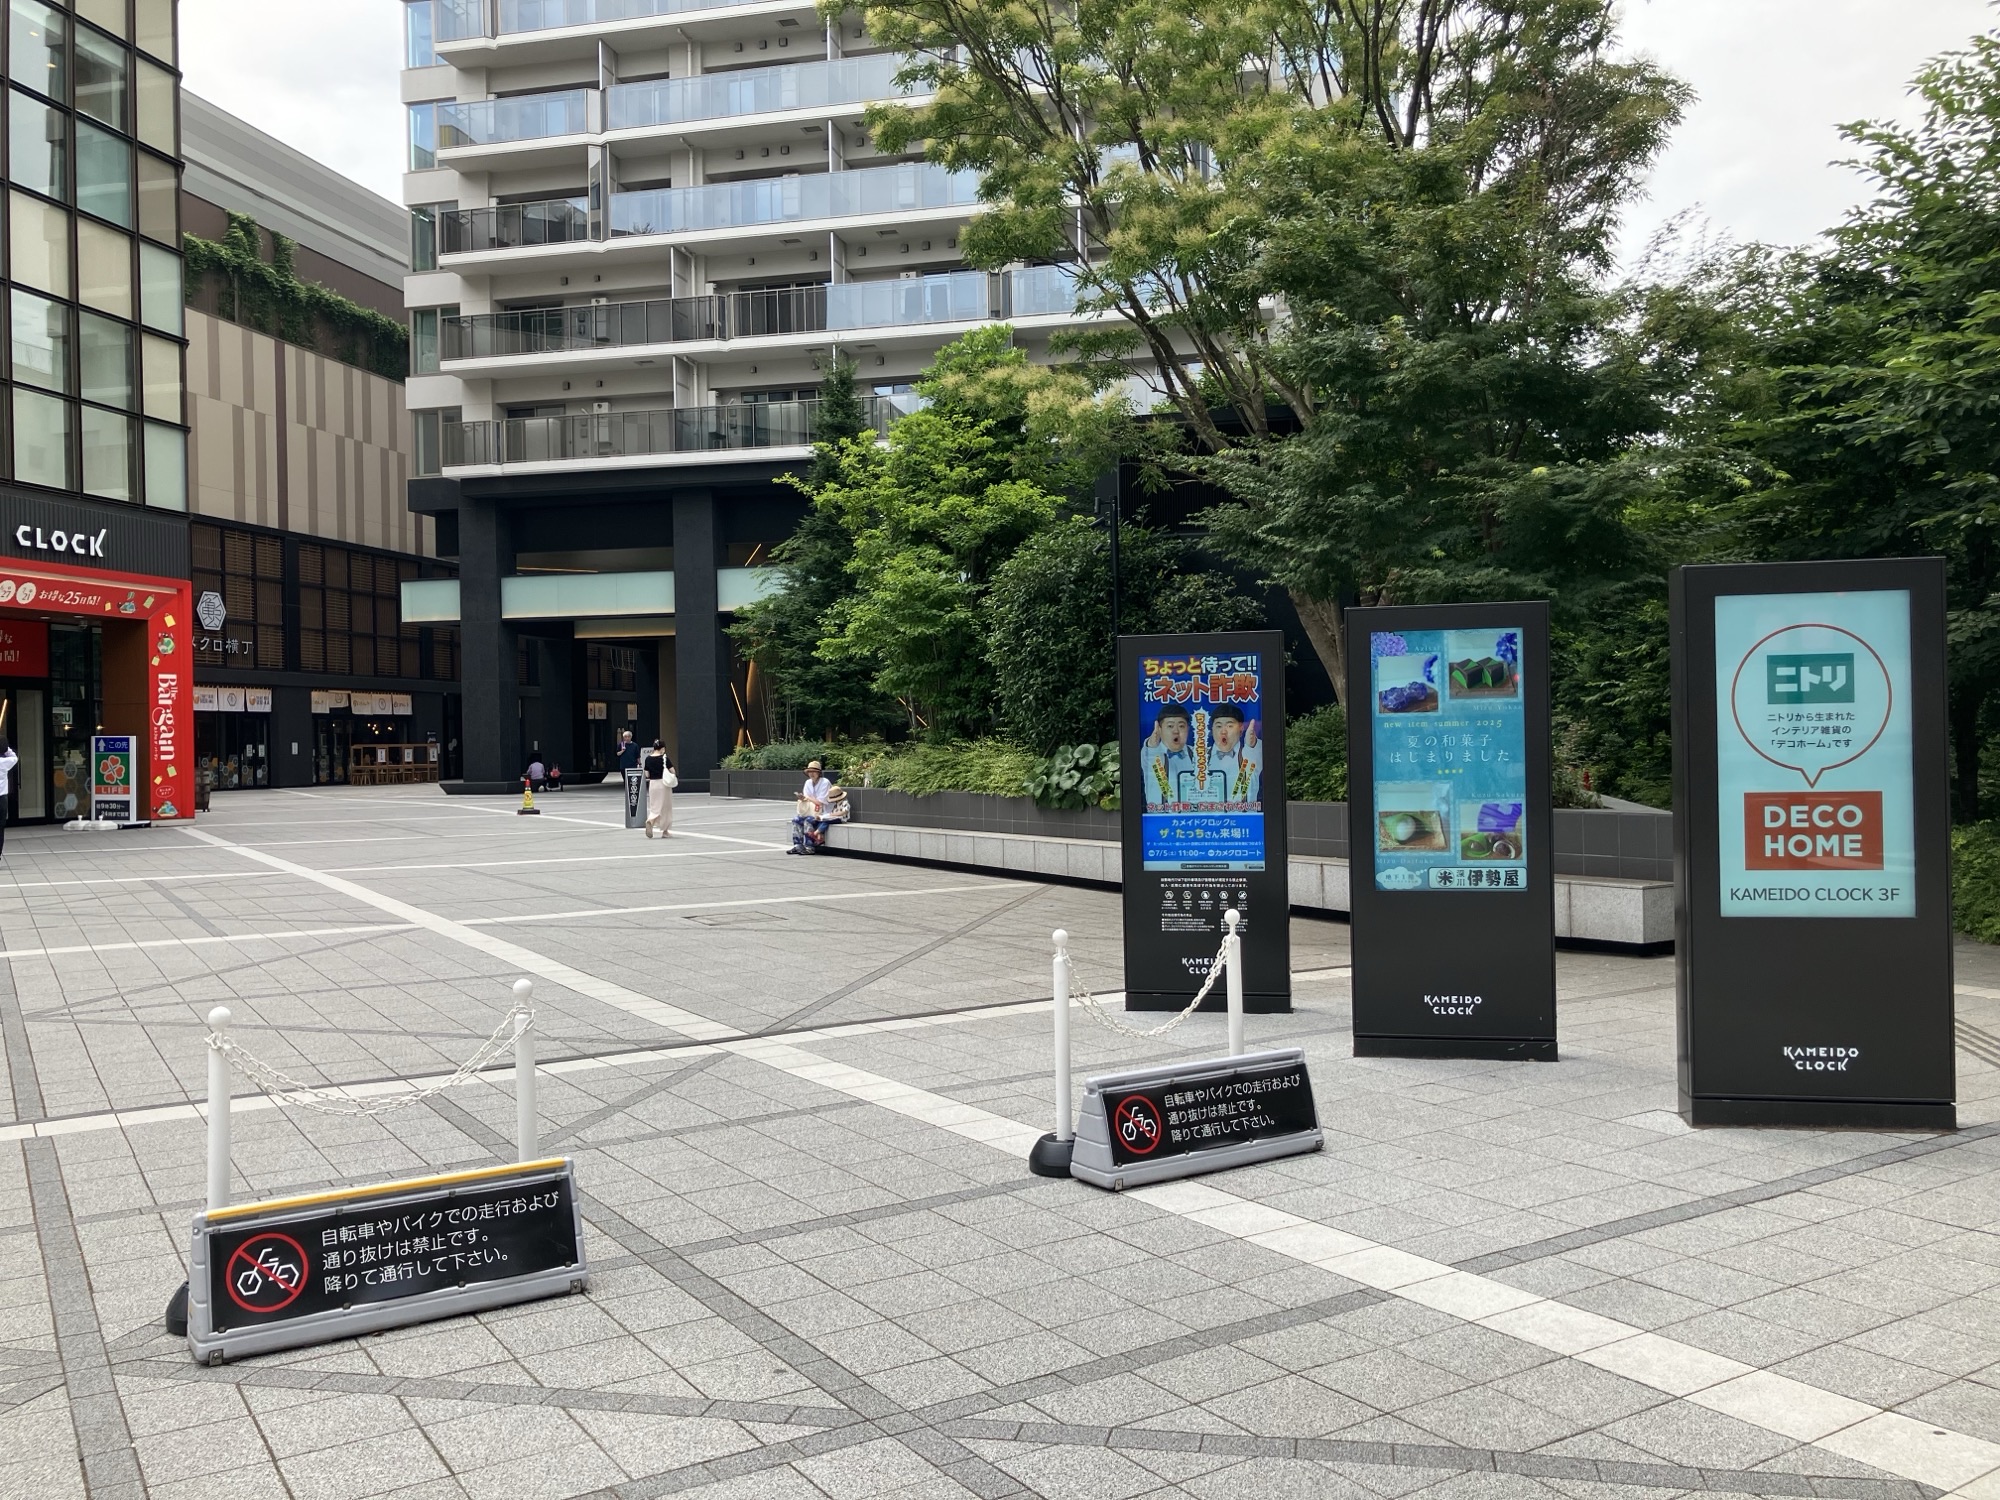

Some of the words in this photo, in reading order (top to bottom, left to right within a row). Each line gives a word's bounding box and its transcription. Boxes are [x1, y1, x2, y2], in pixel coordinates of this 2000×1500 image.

[16, 525, 107, 557] CLOCK
[39, 589, 101, 606] お得な25日間!
[1143, 655, 1257, 675] ちょっと待って!!
[1775, 665, 1847, 692] ニトリ
[1144, 678, 1154, 702] それ
[1154, 672, 1260, 704] ネット詐欺
[152, 673, 177, 760] Bargain
[1408, 719, 1428, 727] item
[1476, 719, 1502, 728] 2025
[1767, 712, 1855, 722] ニトリから生まれた
[1771, 725, 1852, 735] インテリア雑貨の
[108, 741, 128, 749] この先
[1407, 733, 1492, 748] 夏の和菓子
[1771, 738, 1852, 748] 「デコホーム」です
[1390, 750, 1510, 763] はじまりました
[101, 786, 124, 794] LIFE
[1172, 818, 1236, 826] カメイドクロックに
[1764, 804, 1863, 828] DECO
[1159, 828, 1250, 839] ザ・たっちさん来場!!
[1764, 834, 1863, 857] HOME
[1467, 869, 1520, 887] 伊勢屋
[1730, 887, 1810, 901] KAMEIDO
[1815, 887, 1873, 901] CLOCK
[1878, 887, 1900, 901] 3F
[1181, 957, 1223, 967] KAMEI
[1424, 995, 1482, 1006] KAMEIDO
[1432, 1004, 1474, 1015] CLOCK
[1783, 1046, 1859, 1060] KAMEIDO
[1795, 1058, 1849, 1071] CLOCK
[1164, 1073, 1300, 1108] 自転車やバイクでの走行および
[1167, 1098, 1262, 1126] 通り抜けは禁止です。
[1171, 1114, 1275, 1143] 降りて通行して下さい。
[321, 1190, 560, 1247] 自転車やバイクでの走行および
[322, 1228, 489, 1271] 通り抜けは禁止です。
[324, 1247, 509, 1294] 降りて通行して下さい。
